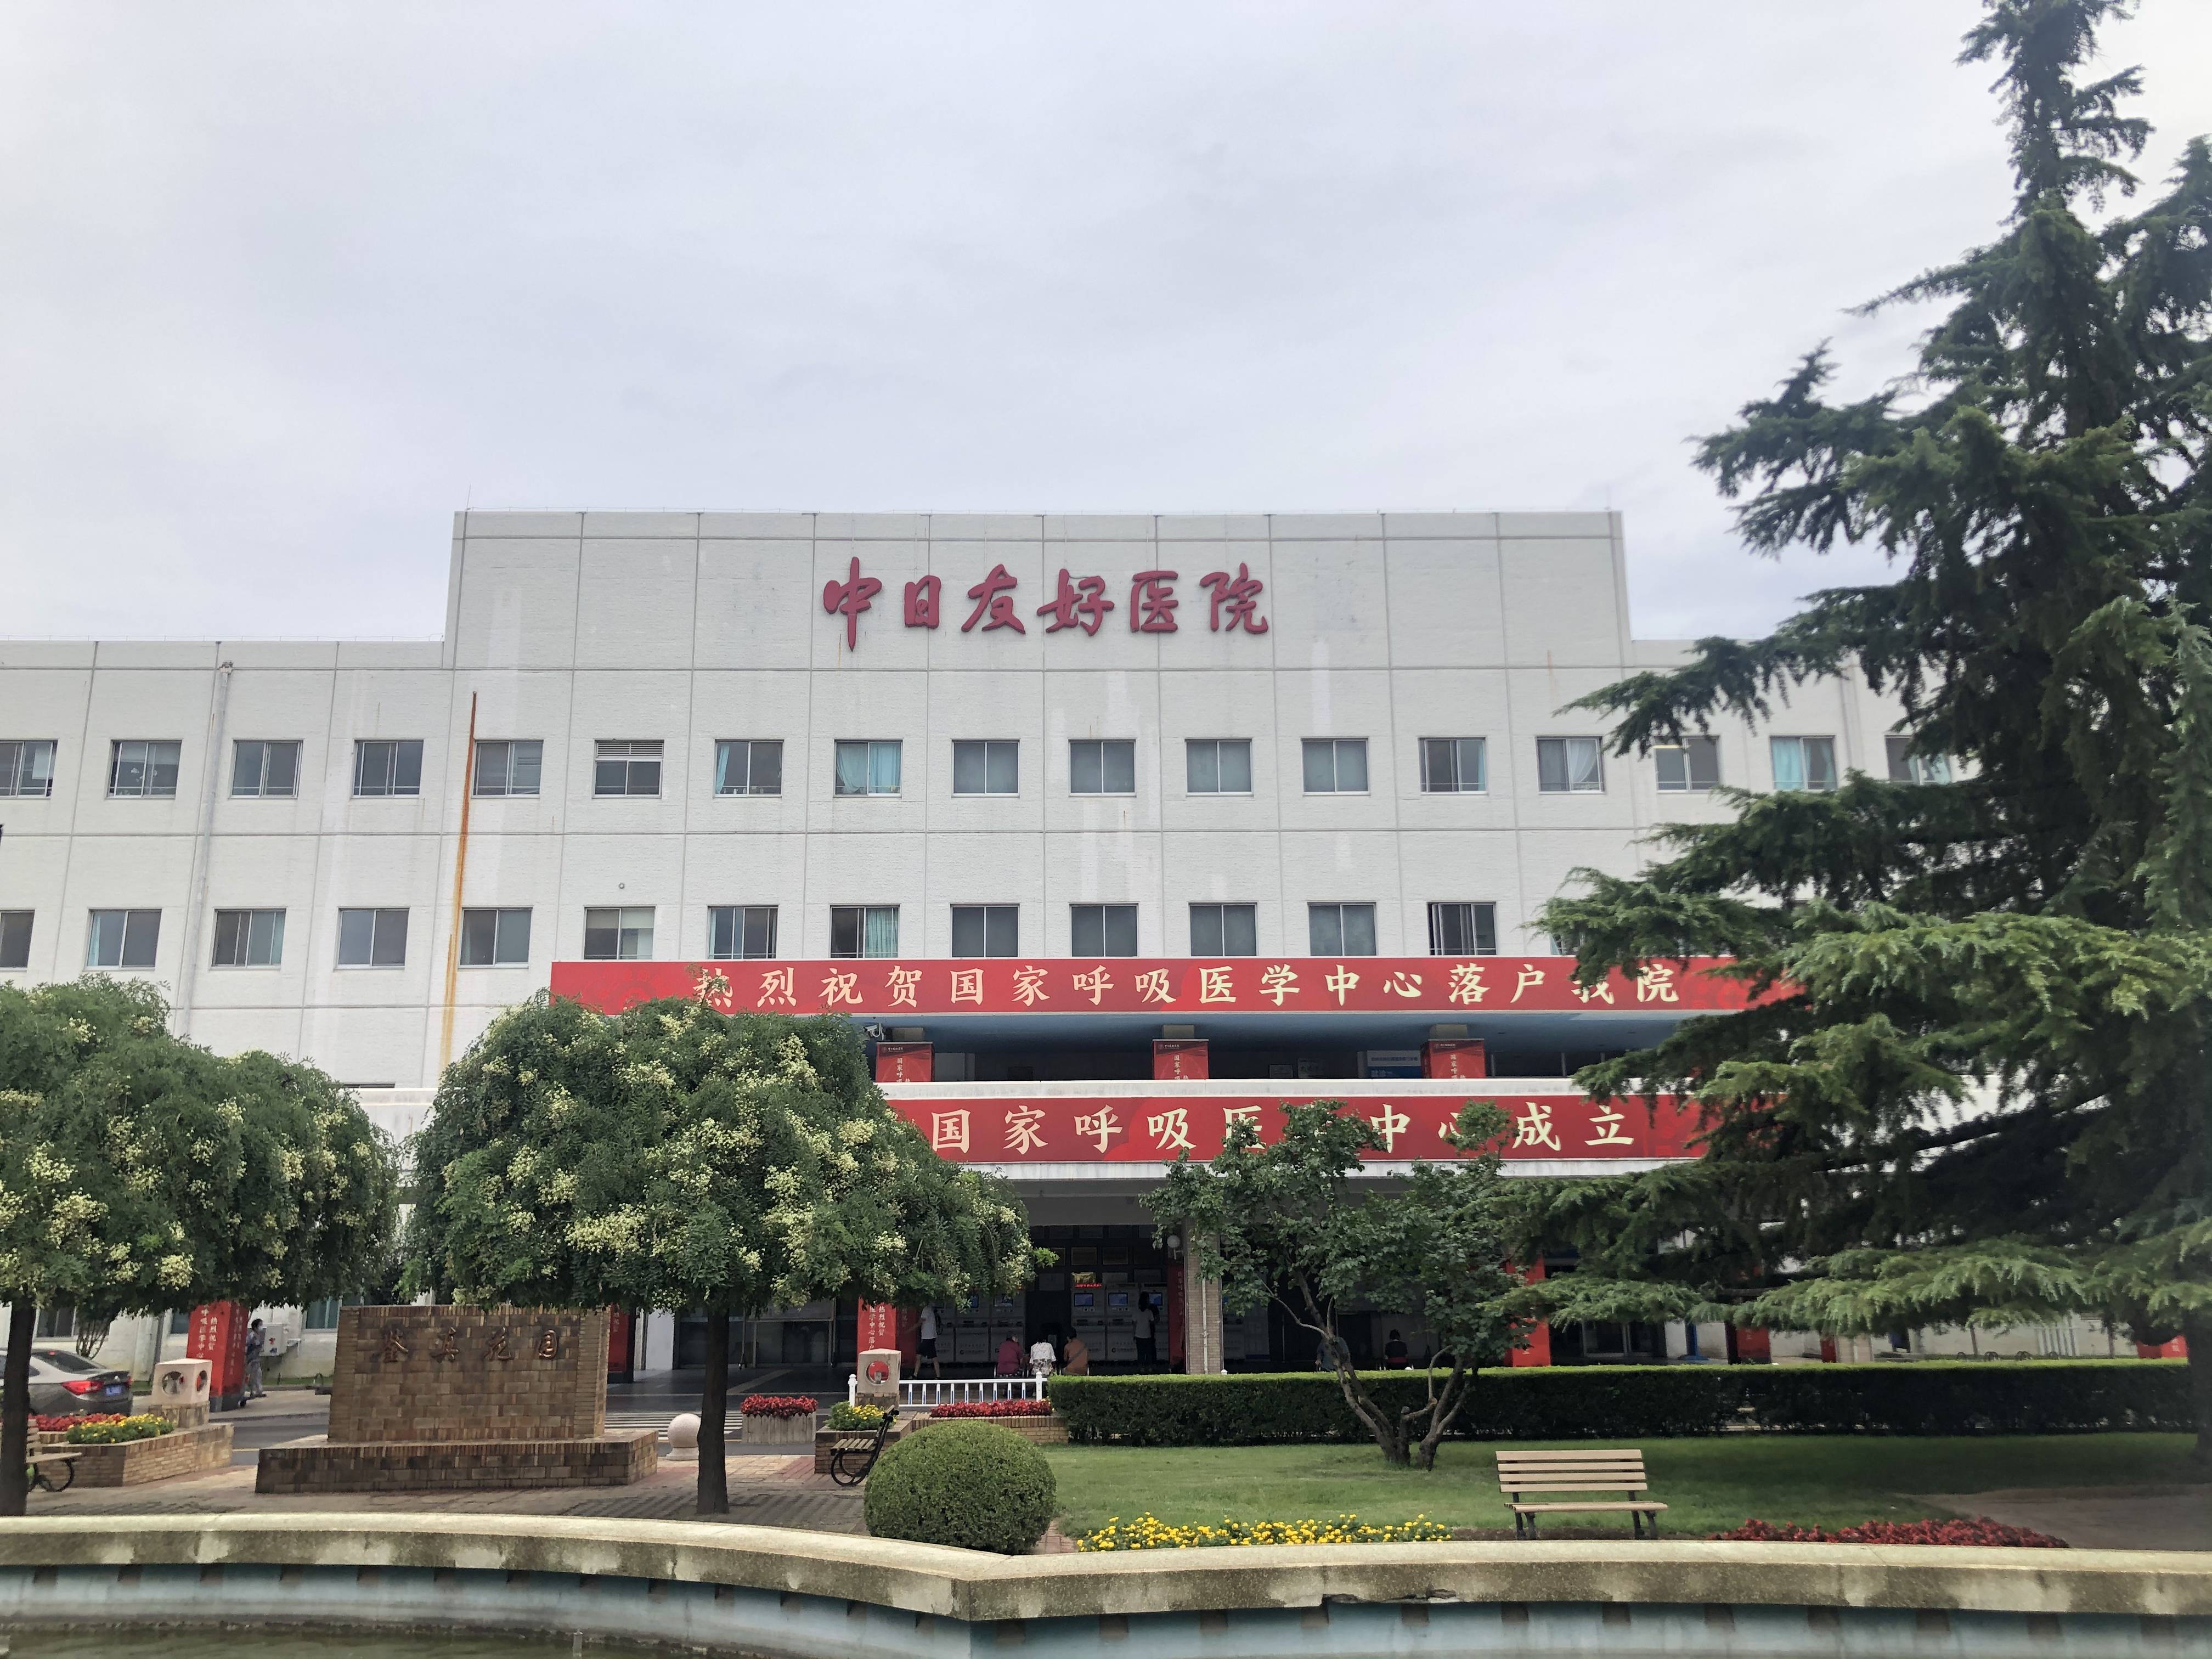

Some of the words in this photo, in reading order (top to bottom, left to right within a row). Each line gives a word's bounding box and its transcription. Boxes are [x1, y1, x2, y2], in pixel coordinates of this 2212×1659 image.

[823, 556, 1269, 651] 中日友好医院
[932, 1102, 1634, 1155] 国家呼吸医中成立
